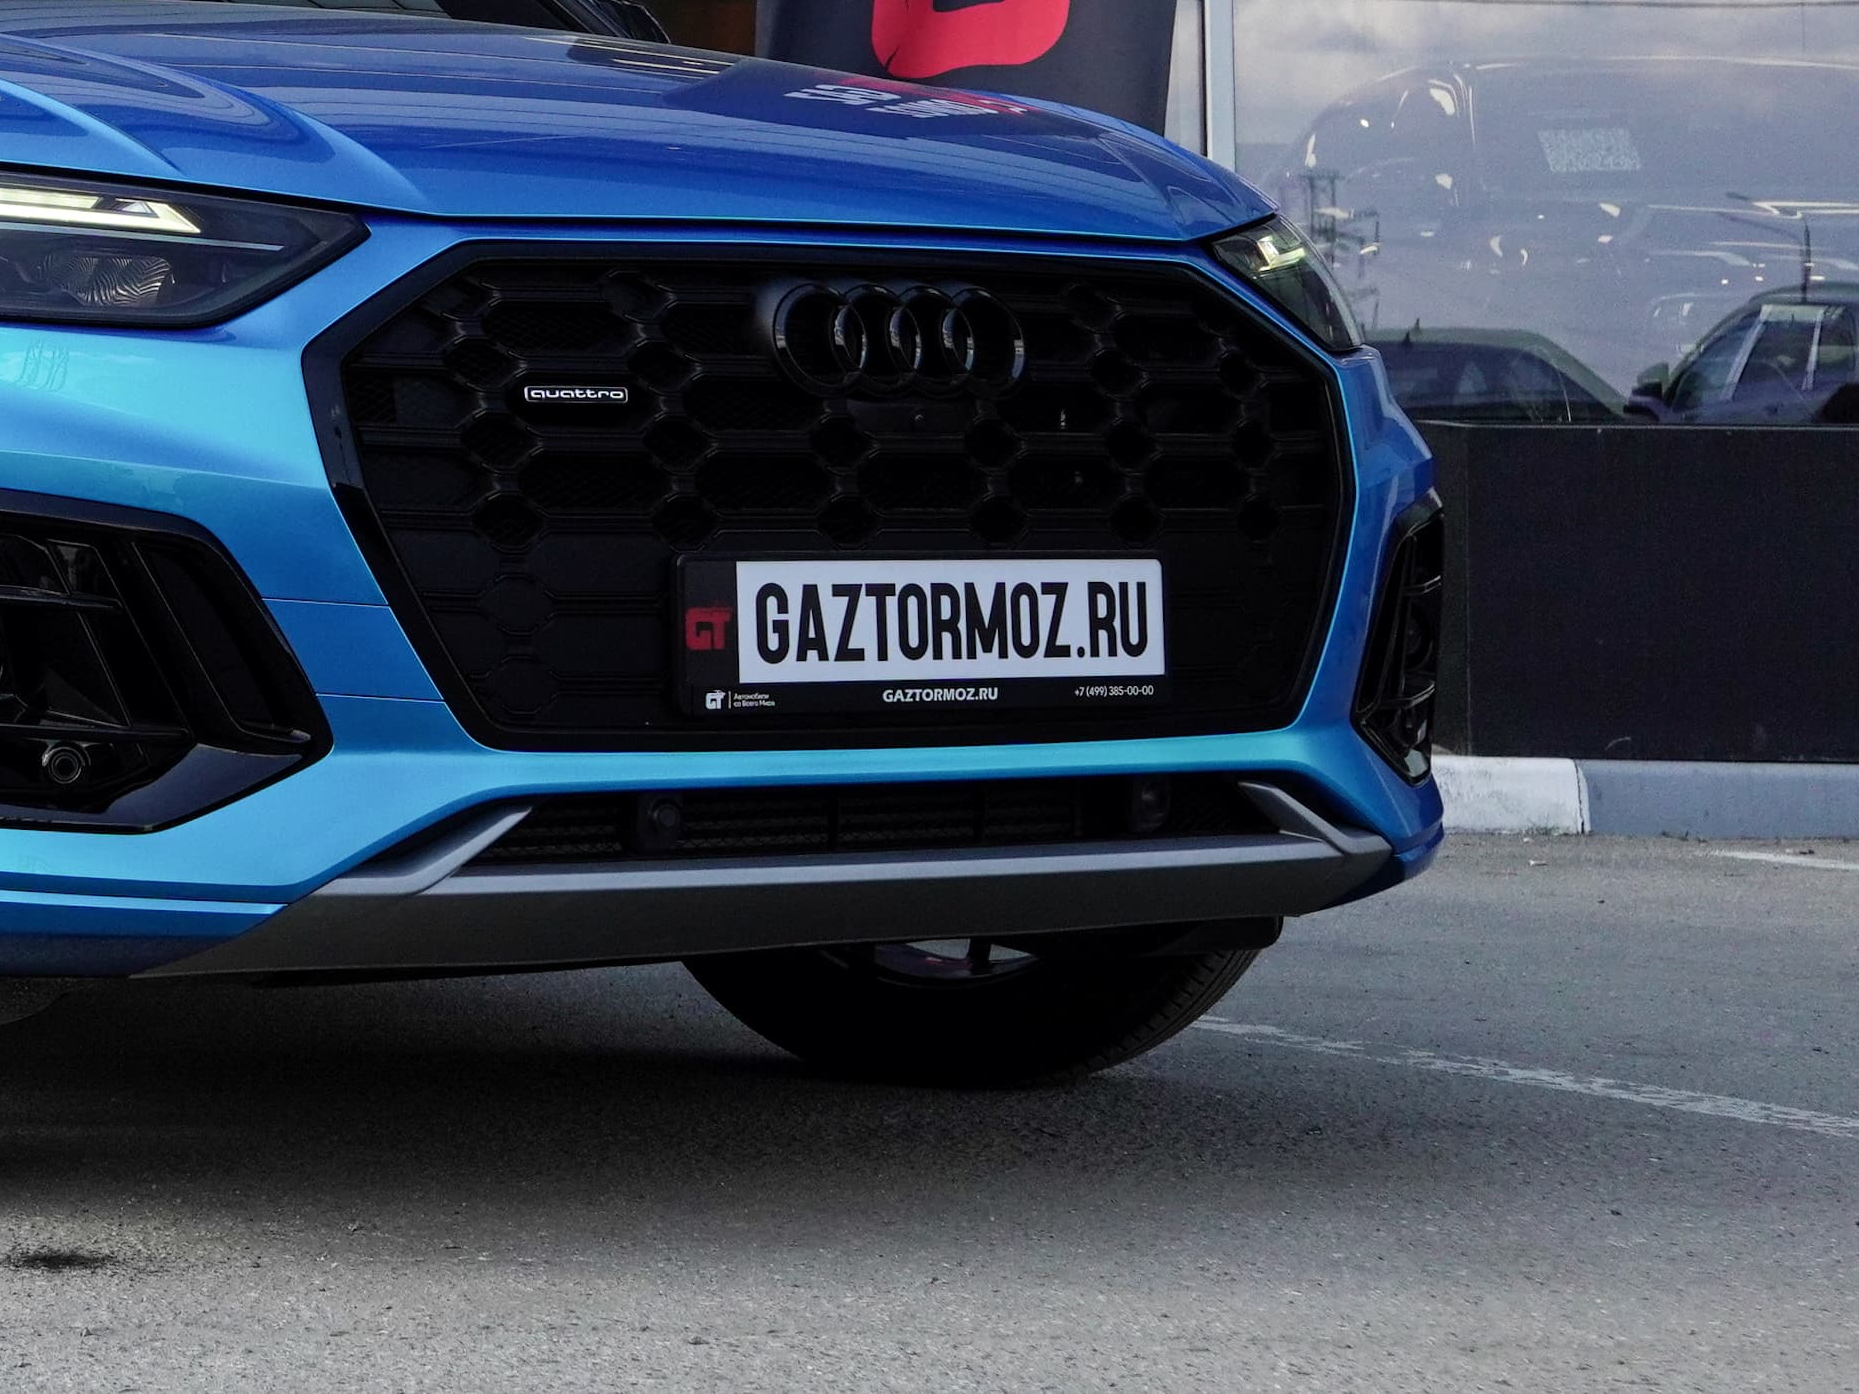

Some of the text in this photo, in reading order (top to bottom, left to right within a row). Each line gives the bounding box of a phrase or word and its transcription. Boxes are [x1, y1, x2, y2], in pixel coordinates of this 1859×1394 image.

[530, 388, 624, 400] quattro
[685, 605, 731, 650] GT
[755, 581, 1148, 664] GAZTORMOZ.RU
[882, 687, 998, 703] GAZTORMOZ.RU
[1074, 685, 1154, 698] +7 (499) 385-00-00
